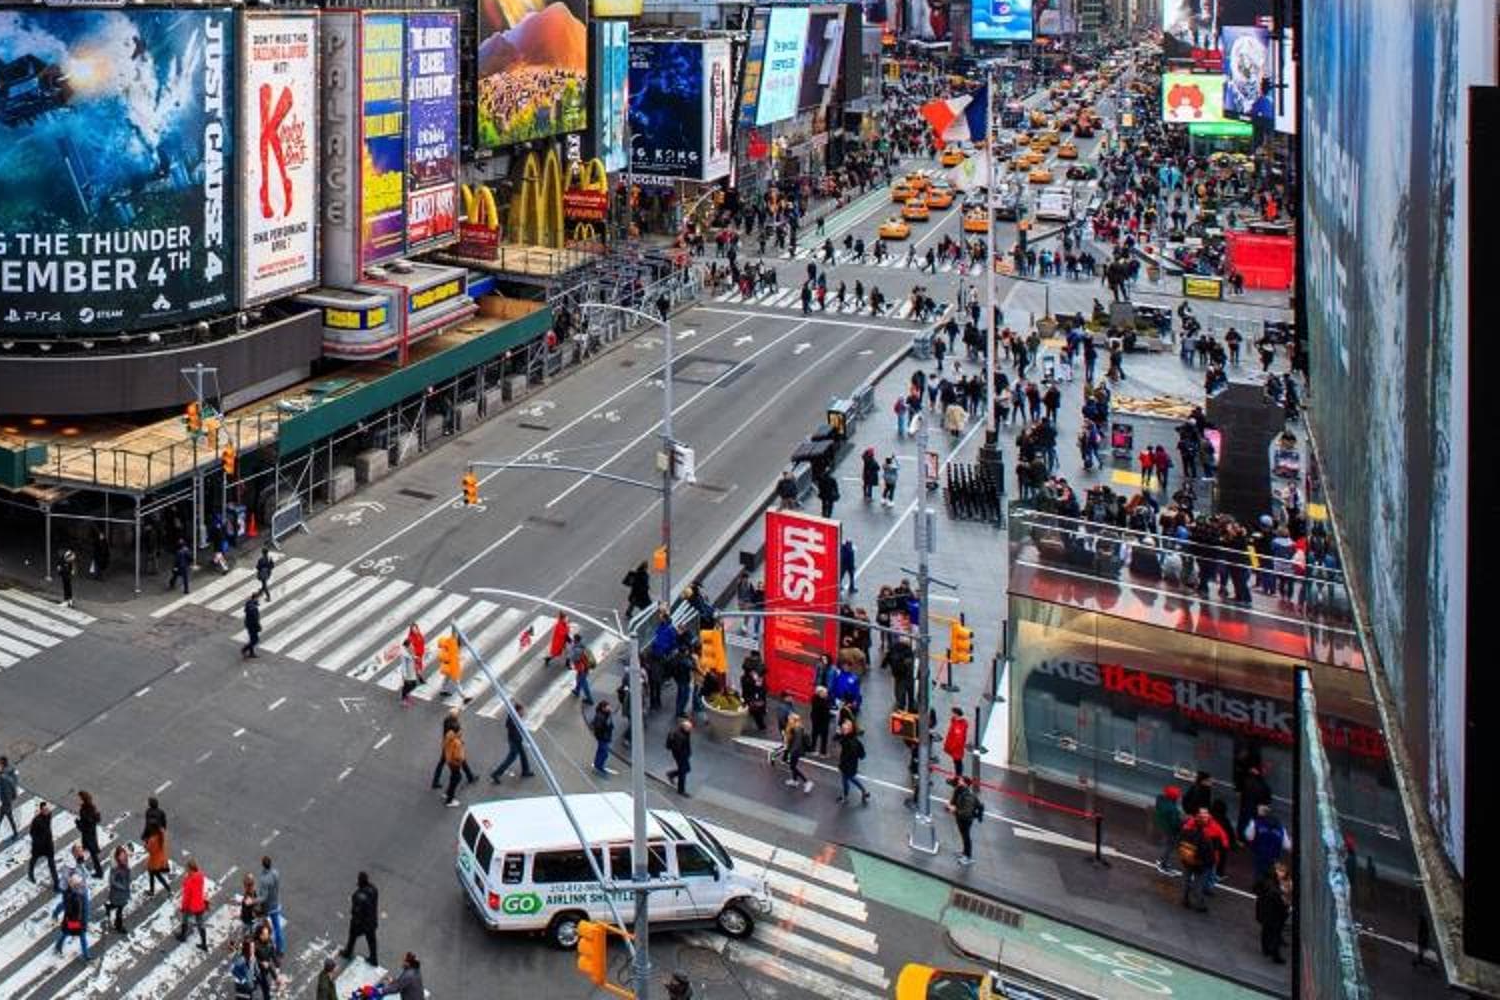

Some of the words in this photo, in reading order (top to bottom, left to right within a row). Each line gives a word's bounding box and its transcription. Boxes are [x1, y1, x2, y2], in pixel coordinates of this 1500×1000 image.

[205, 17, 223, 119] JUST
[327, 32, 346, 224] PALACE
[205, 121, 223, 249] CAUSE
[16, 232, 69, 255] THE
[77, 226, 191, 253] THUNDER
[148, 251, 191, 287] 4TH
[204, 251, 223, 283] 4
[25, 311, 61, 322] PS4
[782, 526, 826, 604] tkts
[505, 897, 535, 911] GO
[547, 893, 587, 905] AIRLINK
